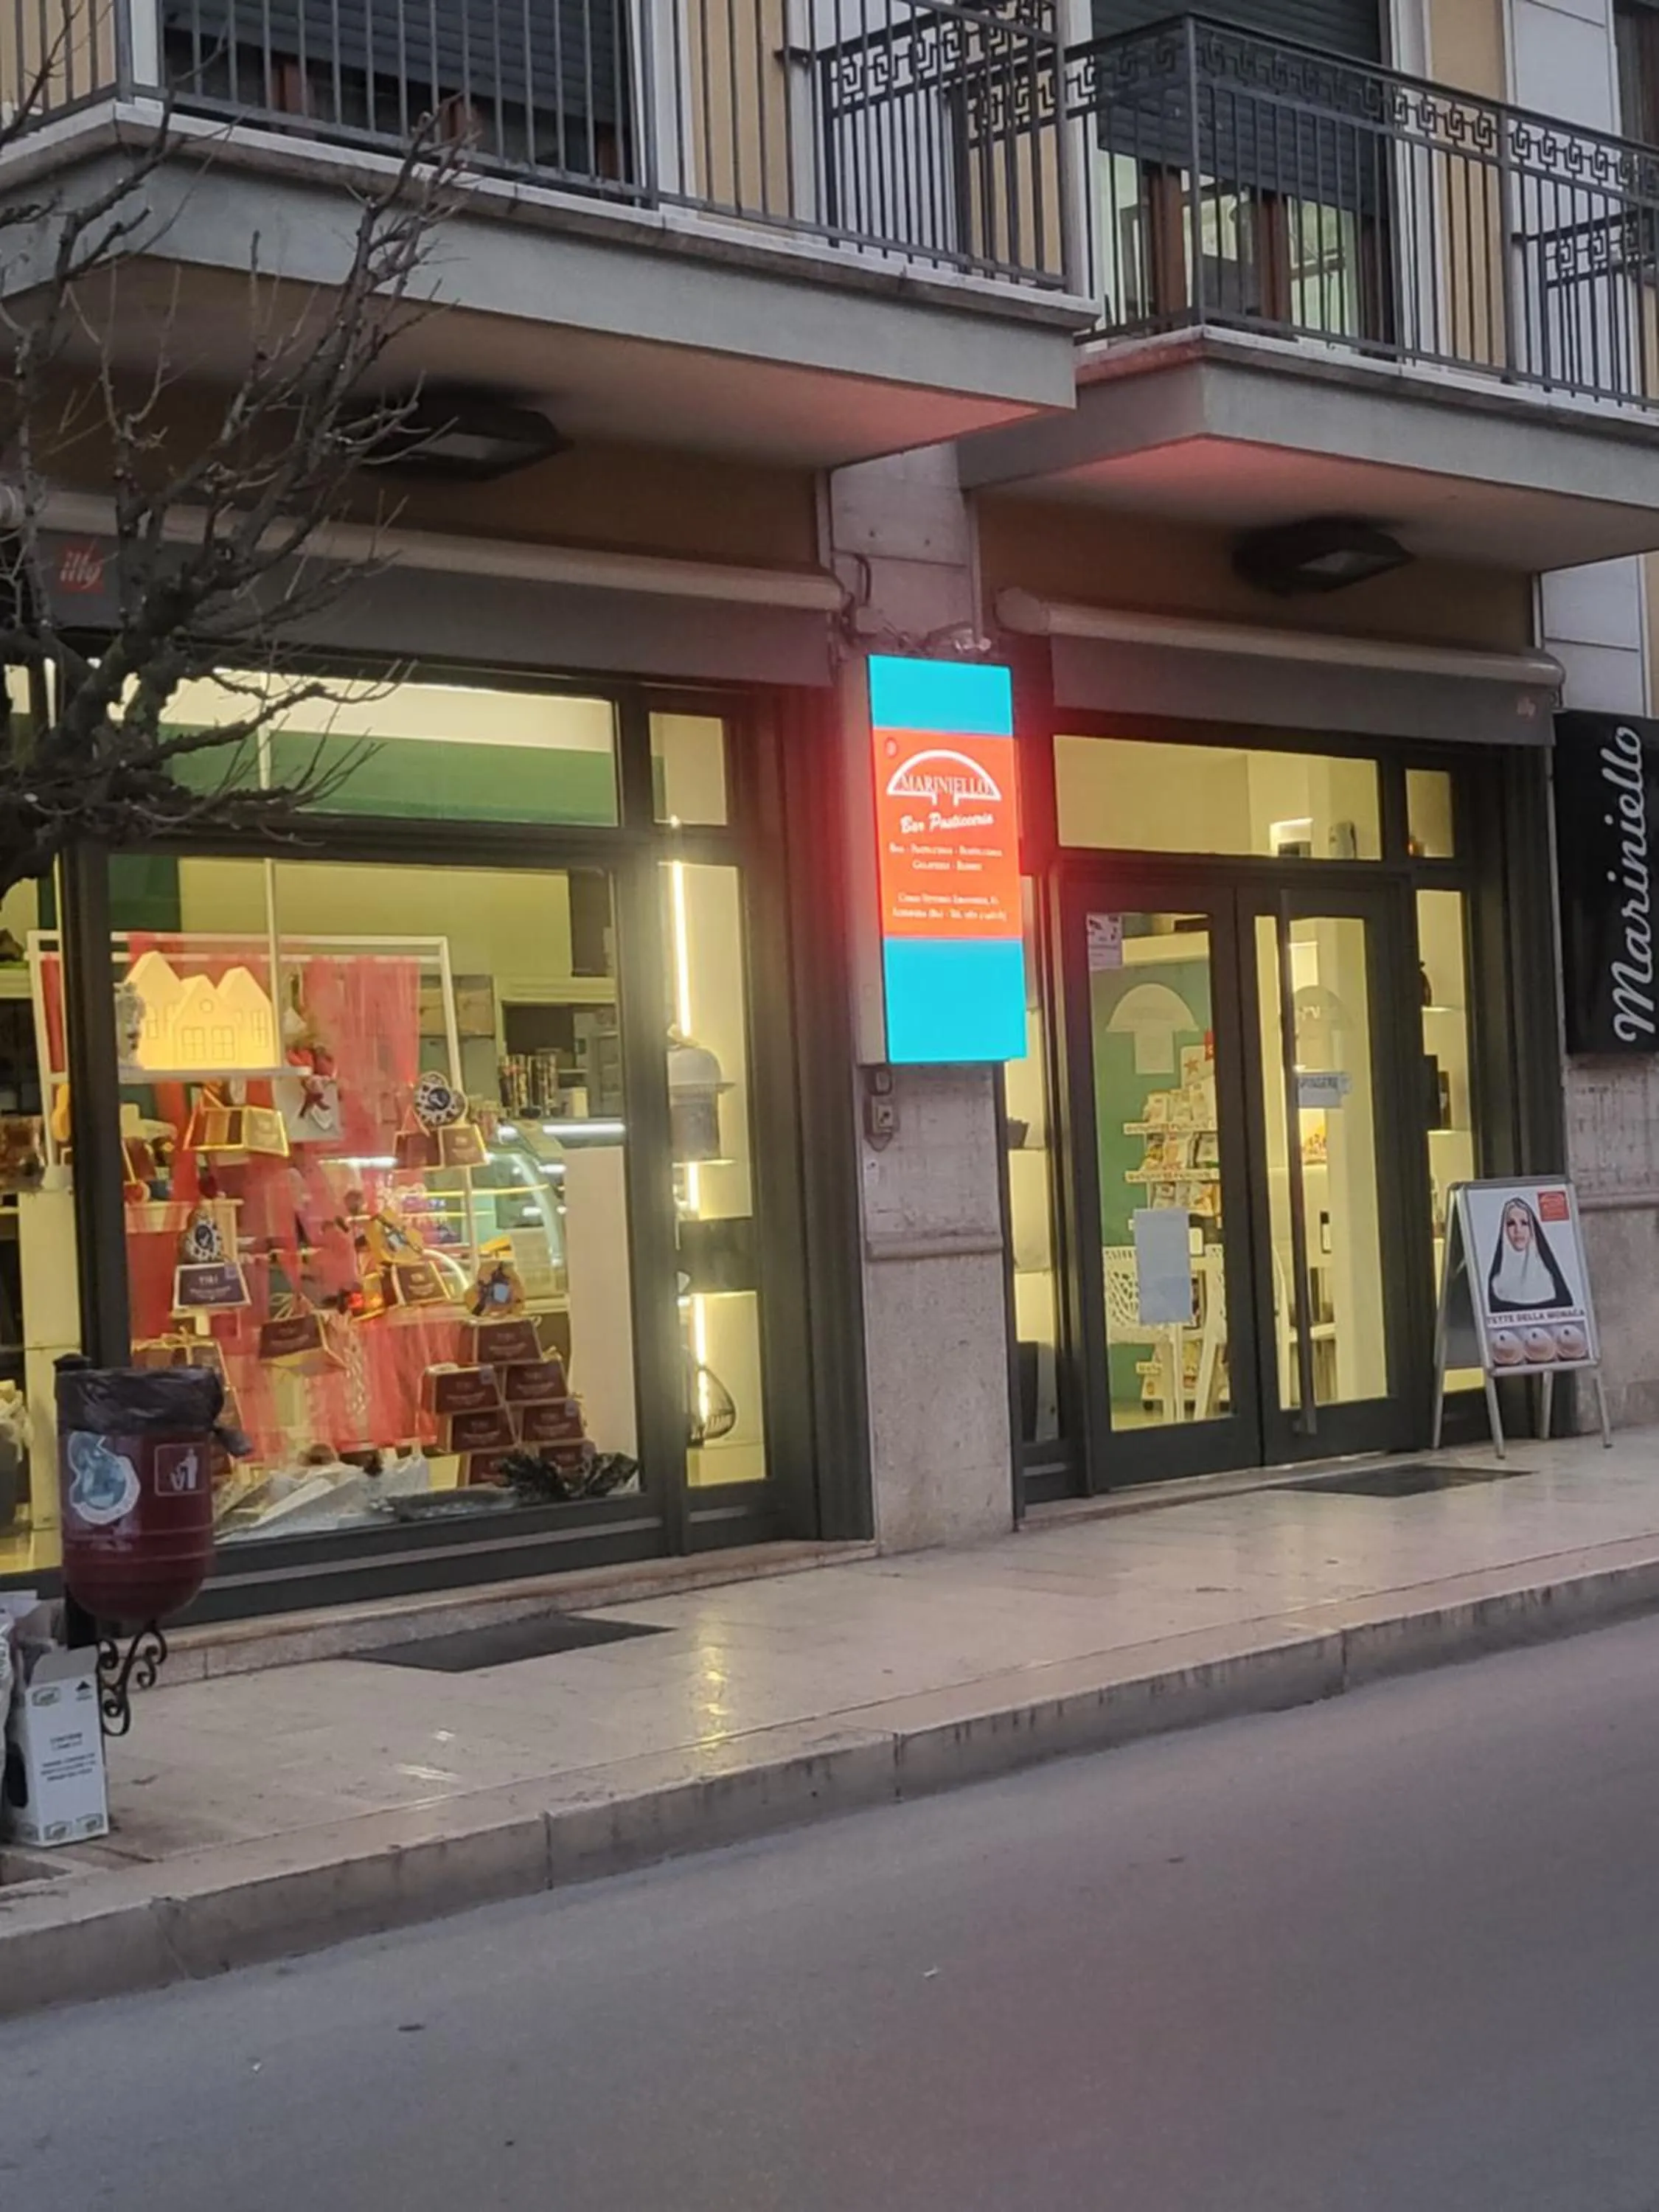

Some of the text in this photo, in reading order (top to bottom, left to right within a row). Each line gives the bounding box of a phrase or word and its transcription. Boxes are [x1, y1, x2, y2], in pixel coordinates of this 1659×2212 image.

[899, 774, 992, 795] MARINIELLO
[900, 814, 925, 835] Bar
[1601, 726, 1656, 1043] Mariniello
[1517, 1312, 1545, 1323] DELLA
